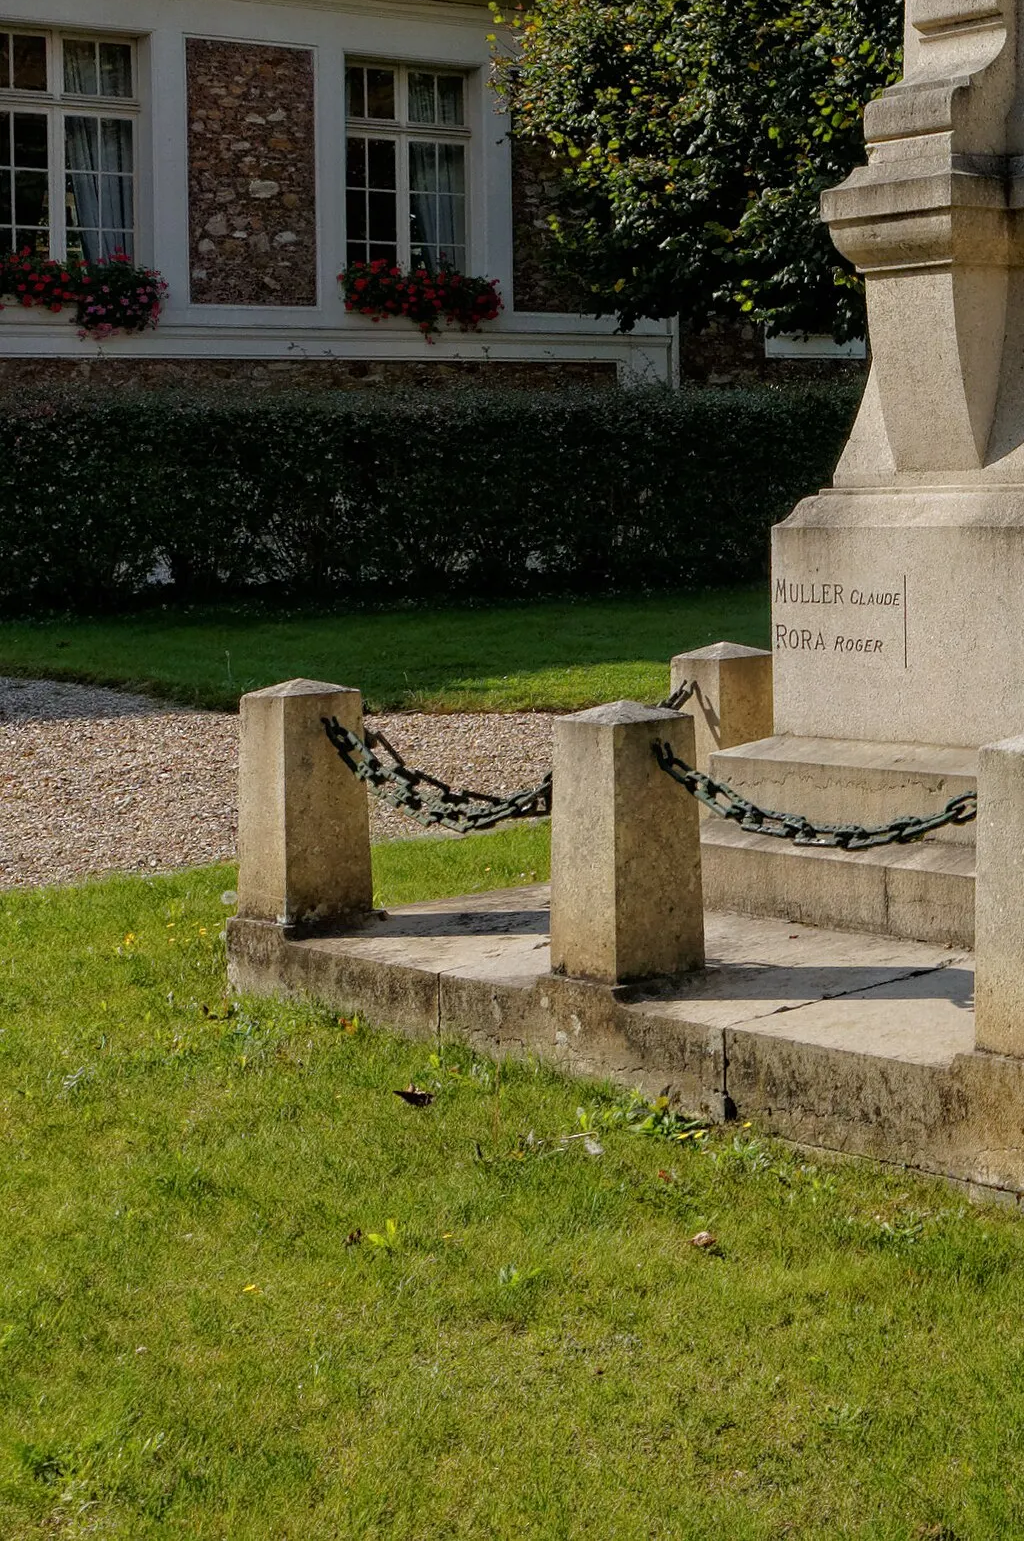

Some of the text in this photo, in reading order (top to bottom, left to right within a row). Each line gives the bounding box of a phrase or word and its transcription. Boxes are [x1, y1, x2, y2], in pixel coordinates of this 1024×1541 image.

[775, 577, 901, 606] MULLER CLAUDE
[776, 624, 884, 653] RORA ROGER
